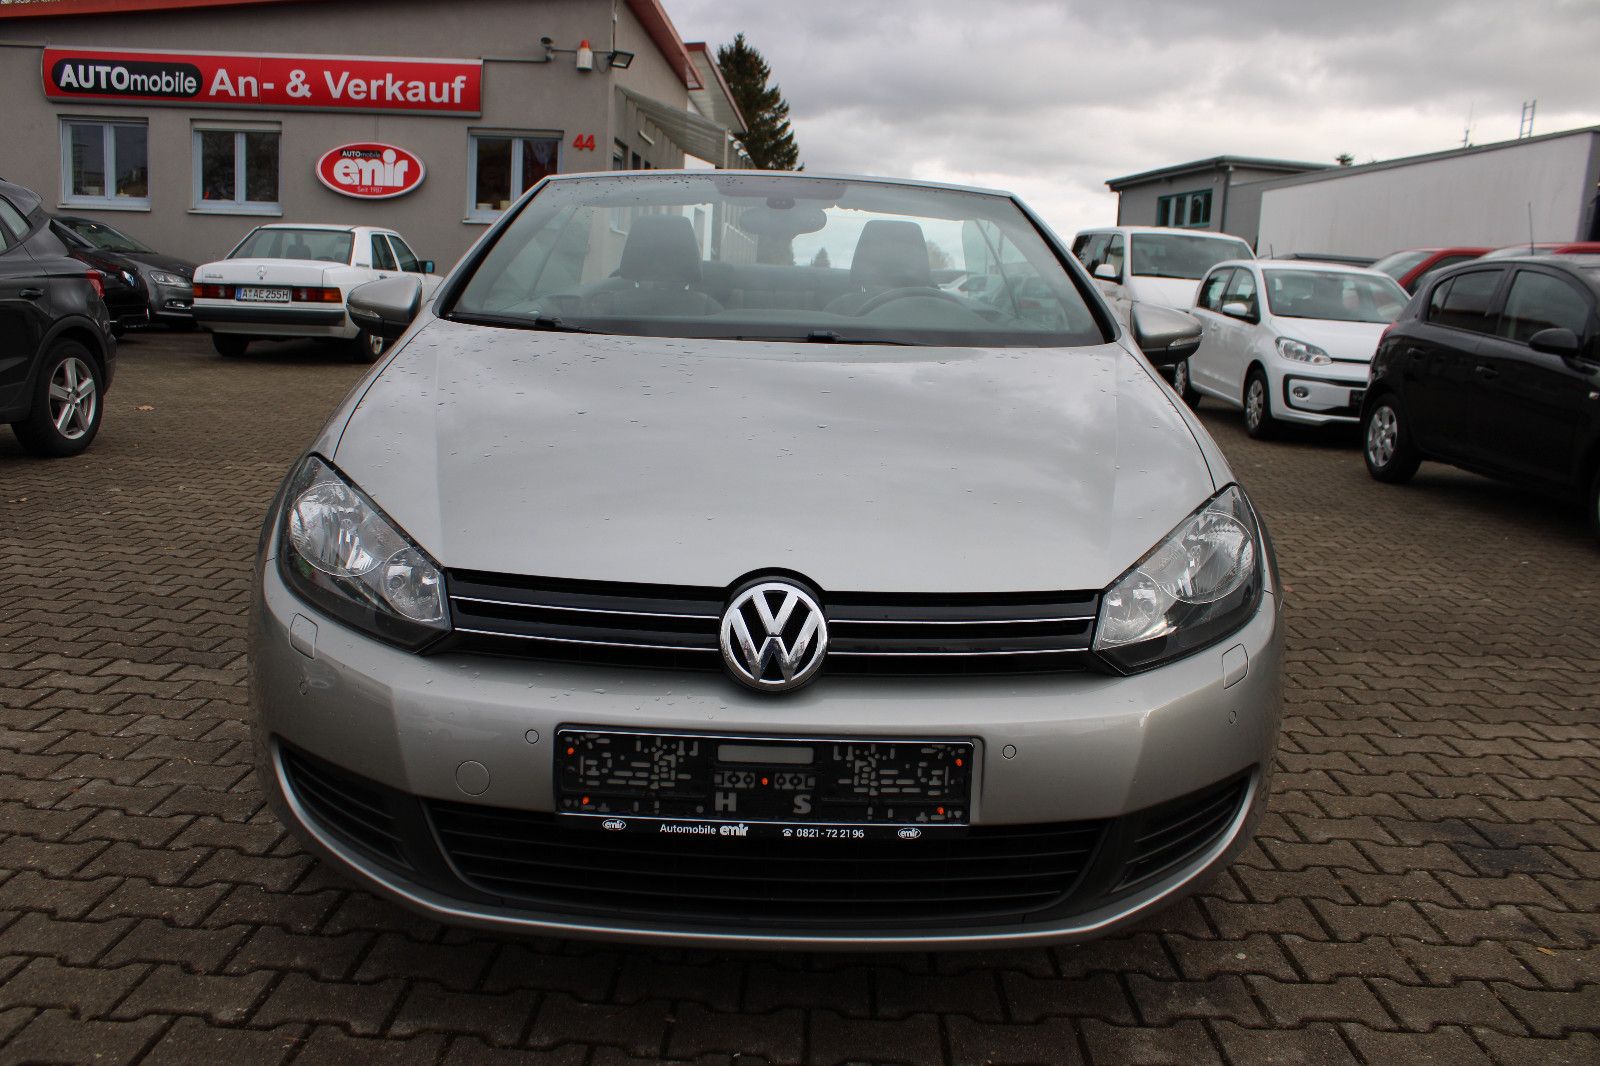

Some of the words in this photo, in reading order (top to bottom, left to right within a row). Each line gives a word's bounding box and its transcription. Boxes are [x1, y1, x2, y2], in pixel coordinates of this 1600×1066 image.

[59, 63, 197, 94] AUTOmobile
[208, 67, 275, 98] An-
[285, 69, 312, 98] &
[323, 70, 467, 104] Verkauf
[572, 133, 596, 151] 44
[333, 149, 409, 187] emir
[604, 820, 624, 830] emir
[660, 823, 716, 835] Automobile
[719, 823, 749, 837] emir
[899, 828, 920, 838] emir
